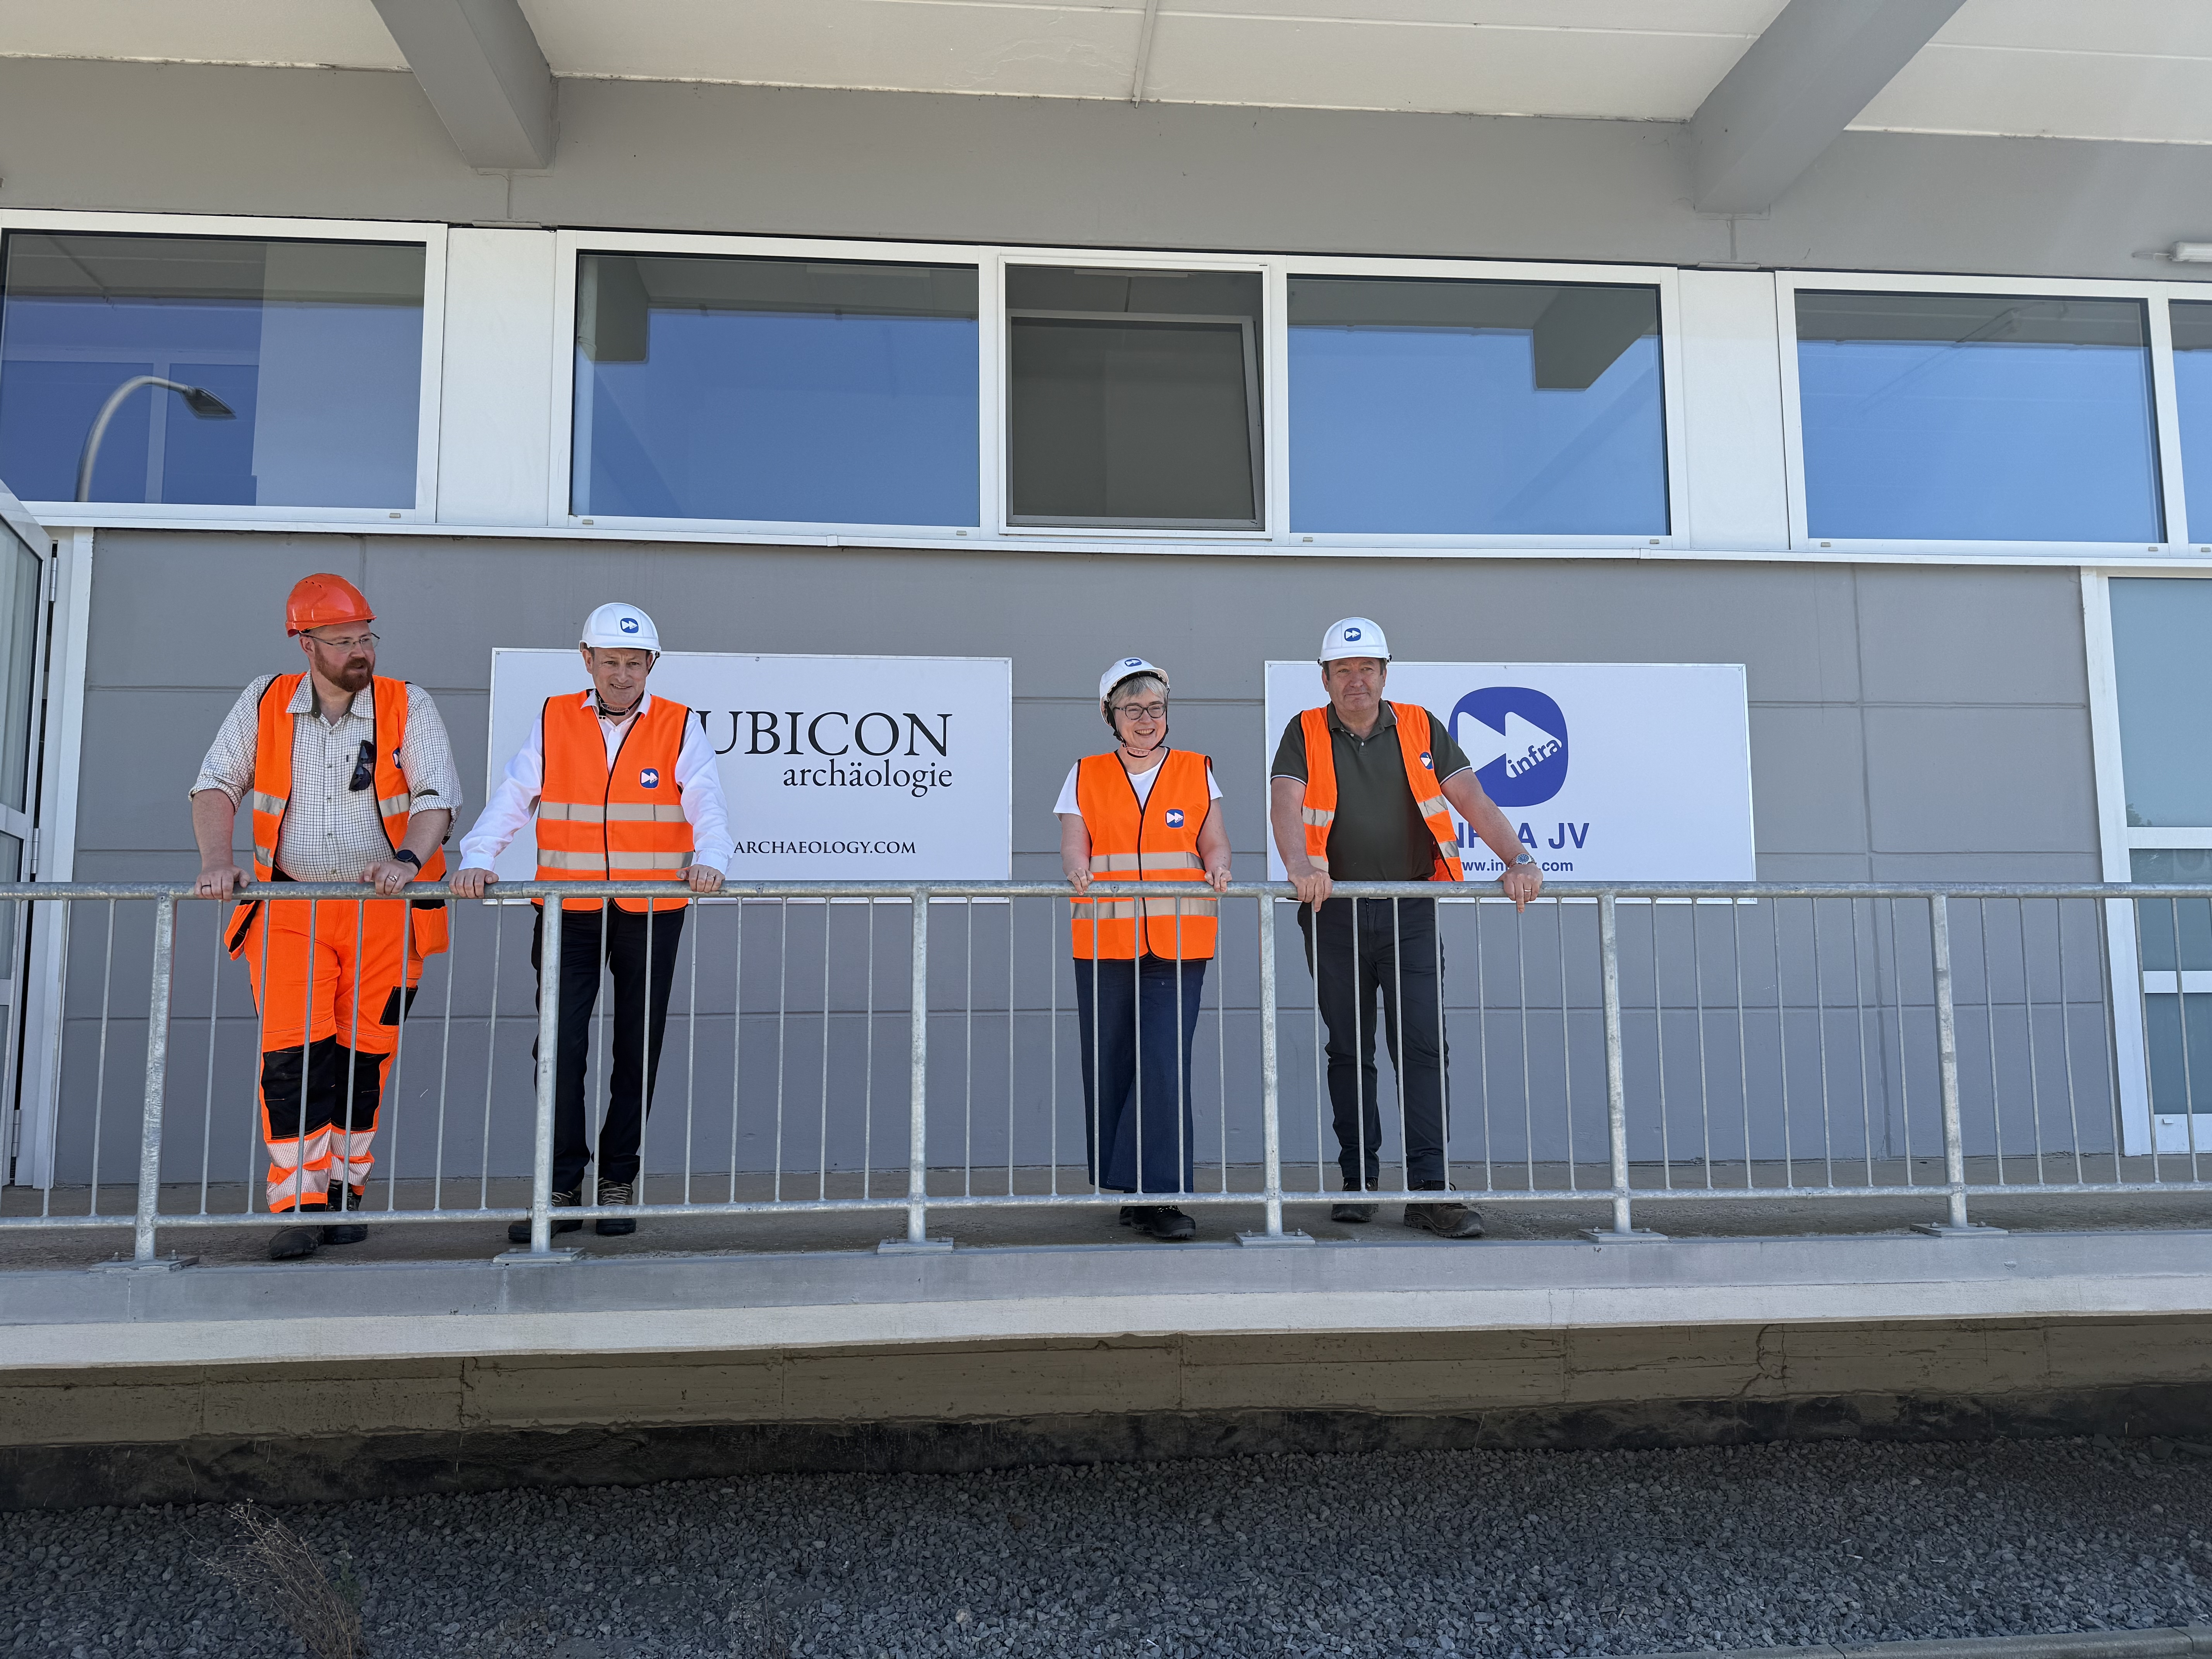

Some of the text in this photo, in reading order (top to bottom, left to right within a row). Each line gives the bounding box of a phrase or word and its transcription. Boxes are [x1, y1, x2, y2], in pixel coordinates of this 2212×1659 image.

[696, 711, 953, 757] UBICON
[1507, 739, 1561, 777] infra
[783, 758, 953, 798] archäologie
[1548, 823, 1590, 849] JV
